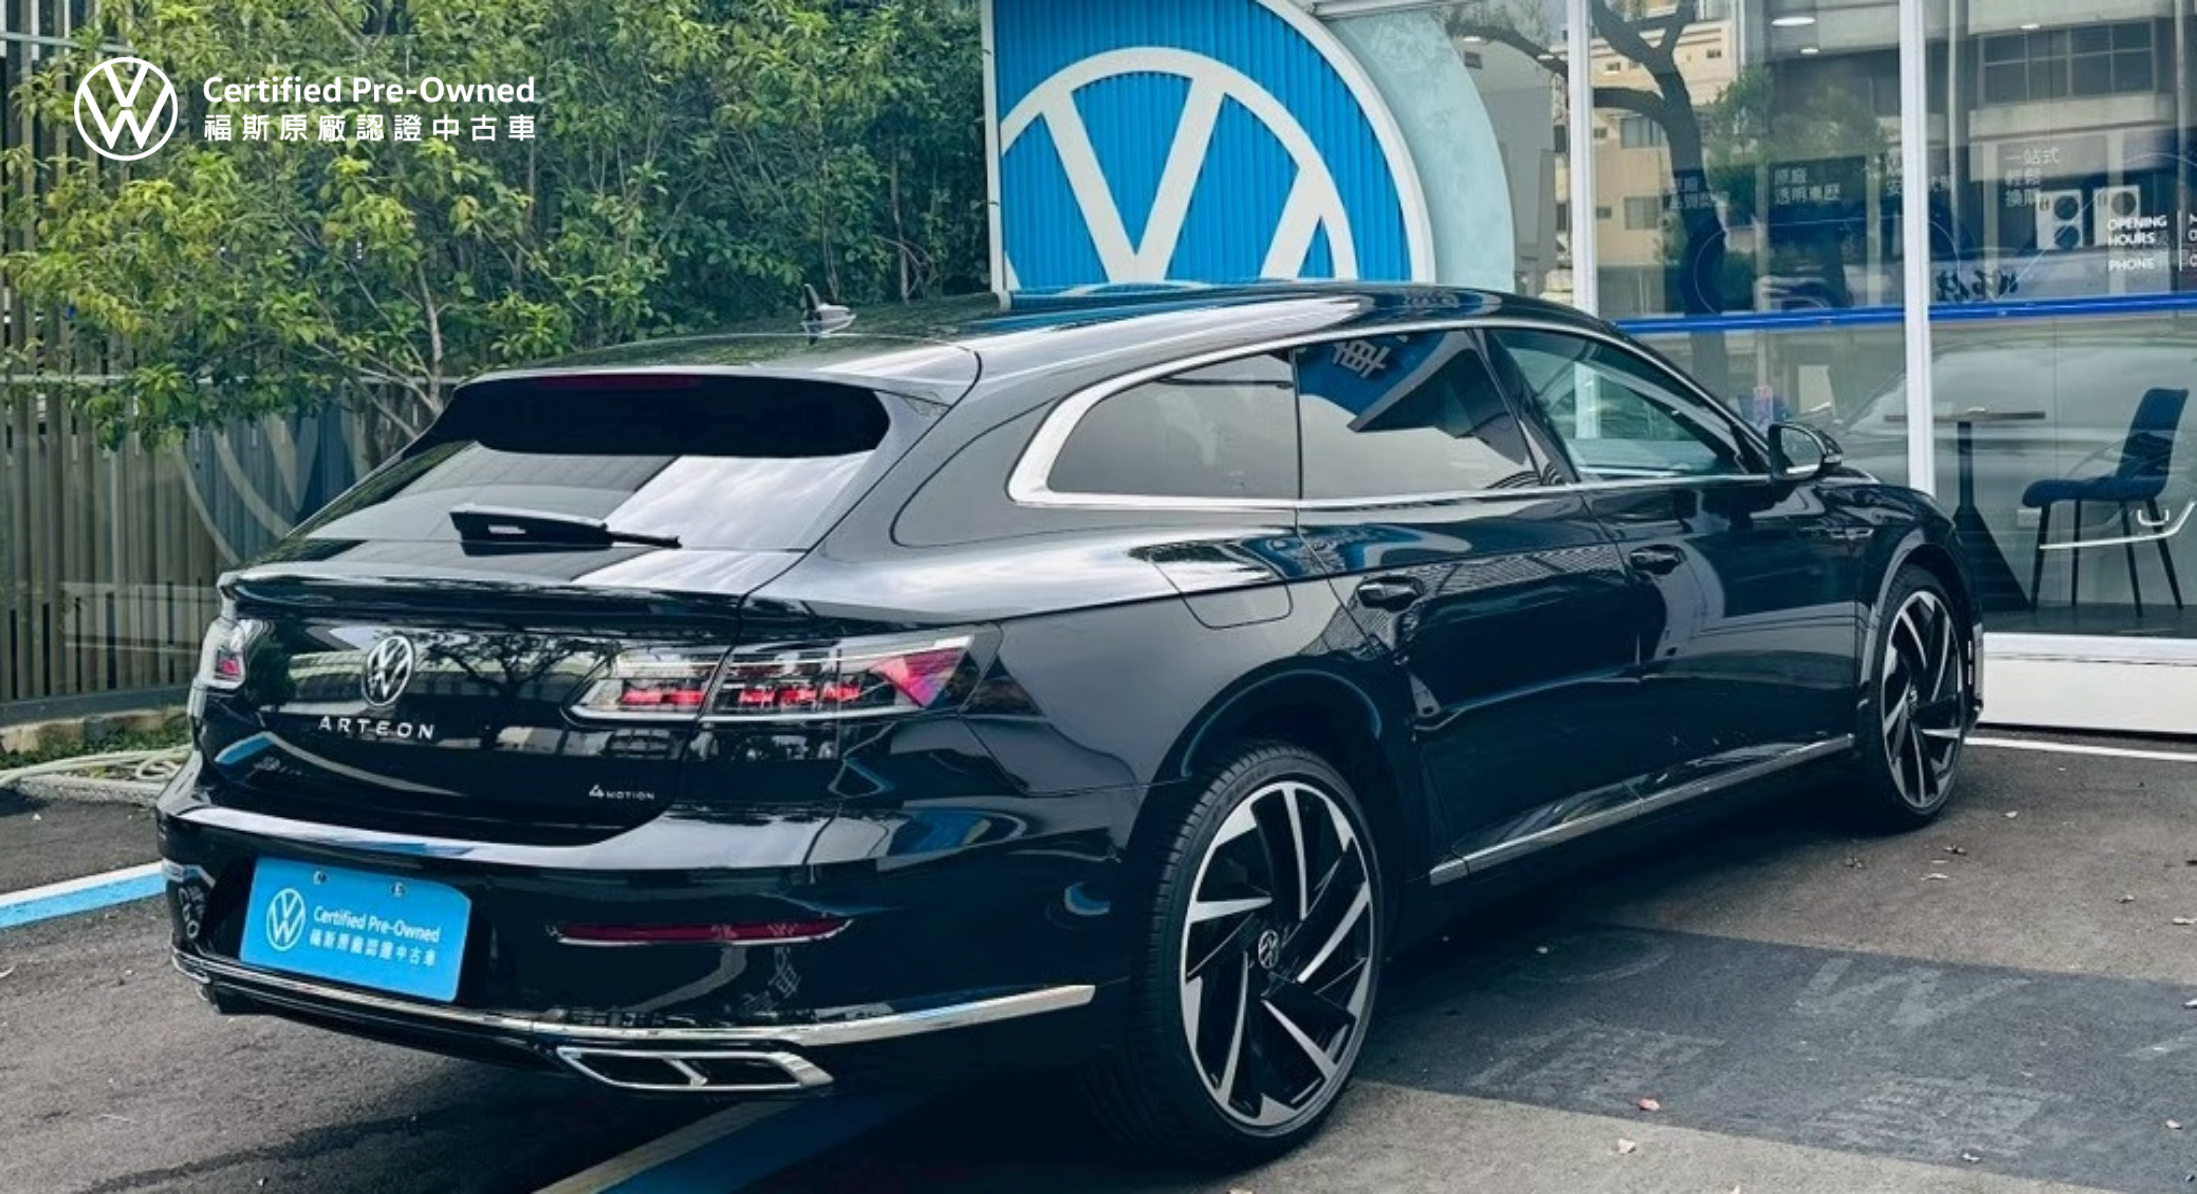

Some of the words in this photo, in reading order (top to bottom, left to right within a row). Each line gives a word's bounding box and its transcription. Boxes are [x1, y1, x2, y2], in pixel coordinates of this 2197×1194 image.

[2107, 214, 2168, 231] OPENING
[2107, 231, 2156, 247] HOURS
[2107, 257, 2156, 272] PHONE
[318, 715, 435, 740] ARTEON
[588, 784, 656, 801] 4MOTION
[313, 905, 367, 931] Certified
[368, 915, 442, 943] Pre-Owned
